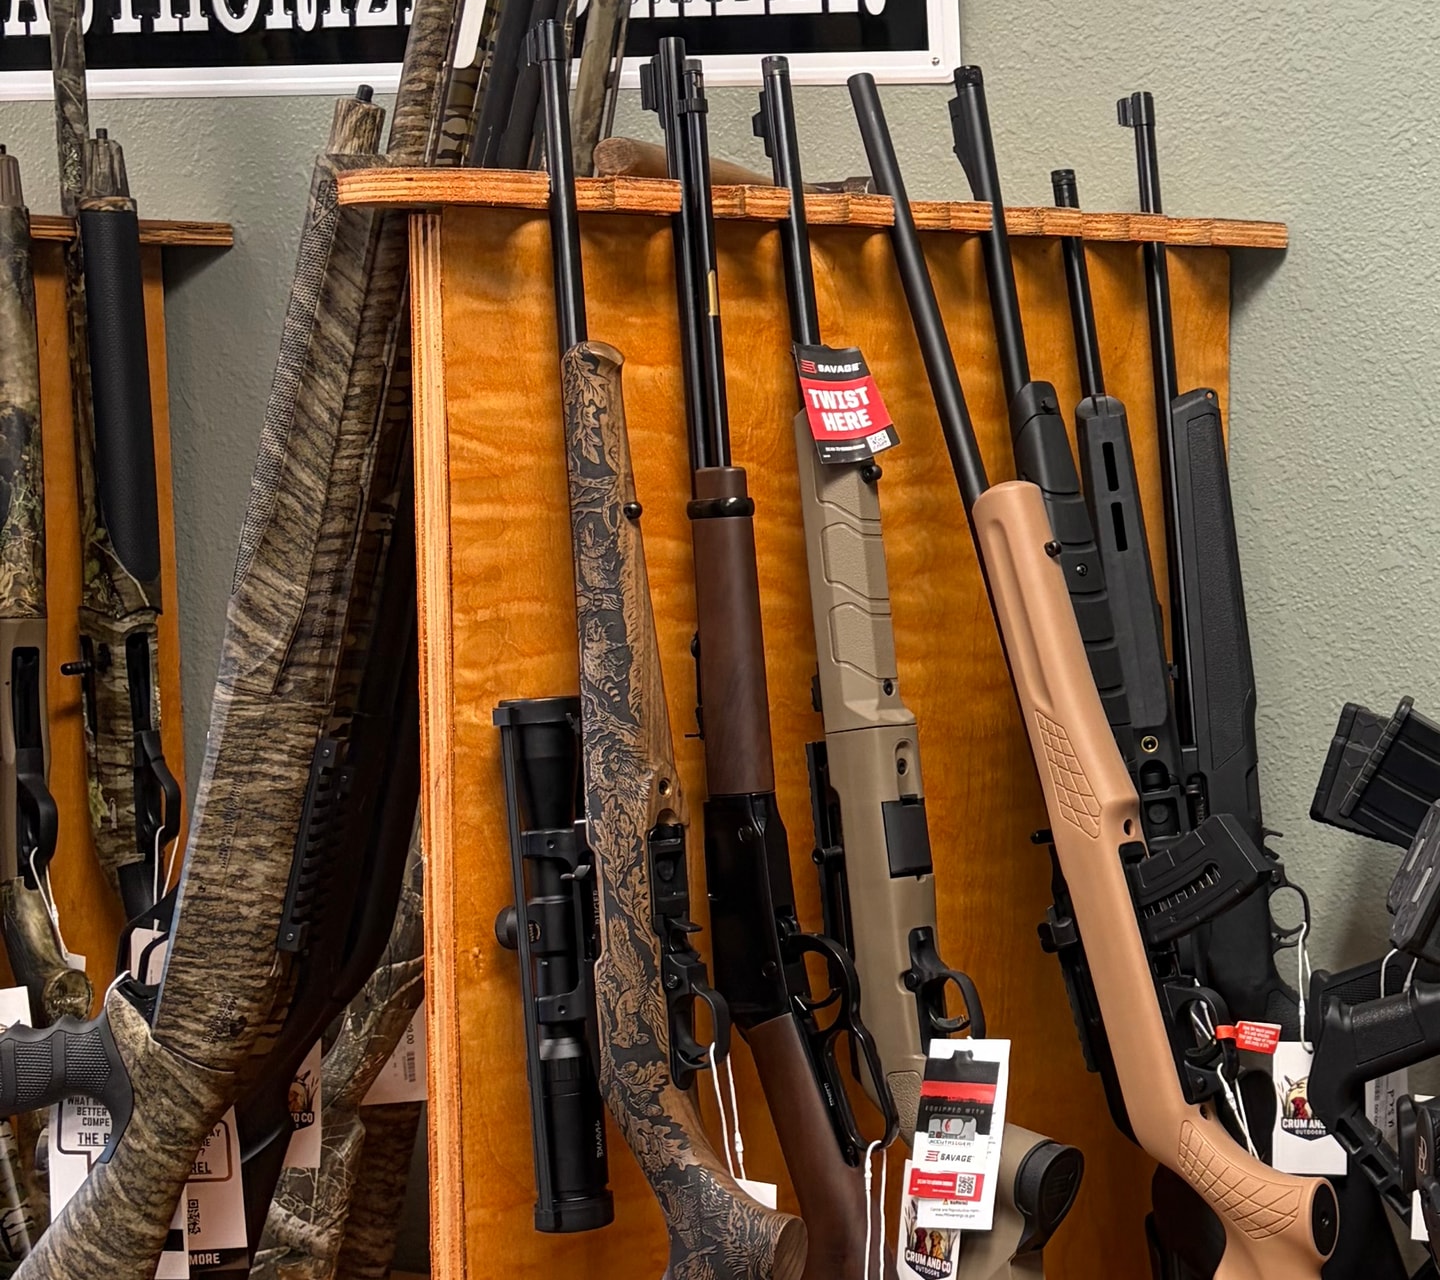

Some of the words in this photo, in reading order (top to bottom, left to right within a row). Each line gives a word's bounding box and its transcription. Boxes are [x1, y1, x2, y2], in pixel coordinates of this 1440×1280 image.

[818, 362, 860, 373] SAVAGE
[807, 386, 870, 410] TWIST
[821, 409, 872, 432] HERE
[68, 1096, 90, 1106] WHAT
[77, 1107, 107, 1116] BETTER
[925, 1105, 961, 1113] EQUIPPED
[82, 1117, 110, 1127] COMPE
[301, 1113, 313, 1122] CO
[1282, 1118, 1307, 1129] CRUM
[78, 1133, 99, 1145] THE
[940, 1153, 972, 1162] SAVAGE
[189, 1253, 220, 1265] MORE
[905, 1250, 926, 1265] CRUM
[926, 1255, 940, 1269] AND
[941, 1260, 951, 1274] CO
[915, 1265, 940, 1277] OUTDOORS
